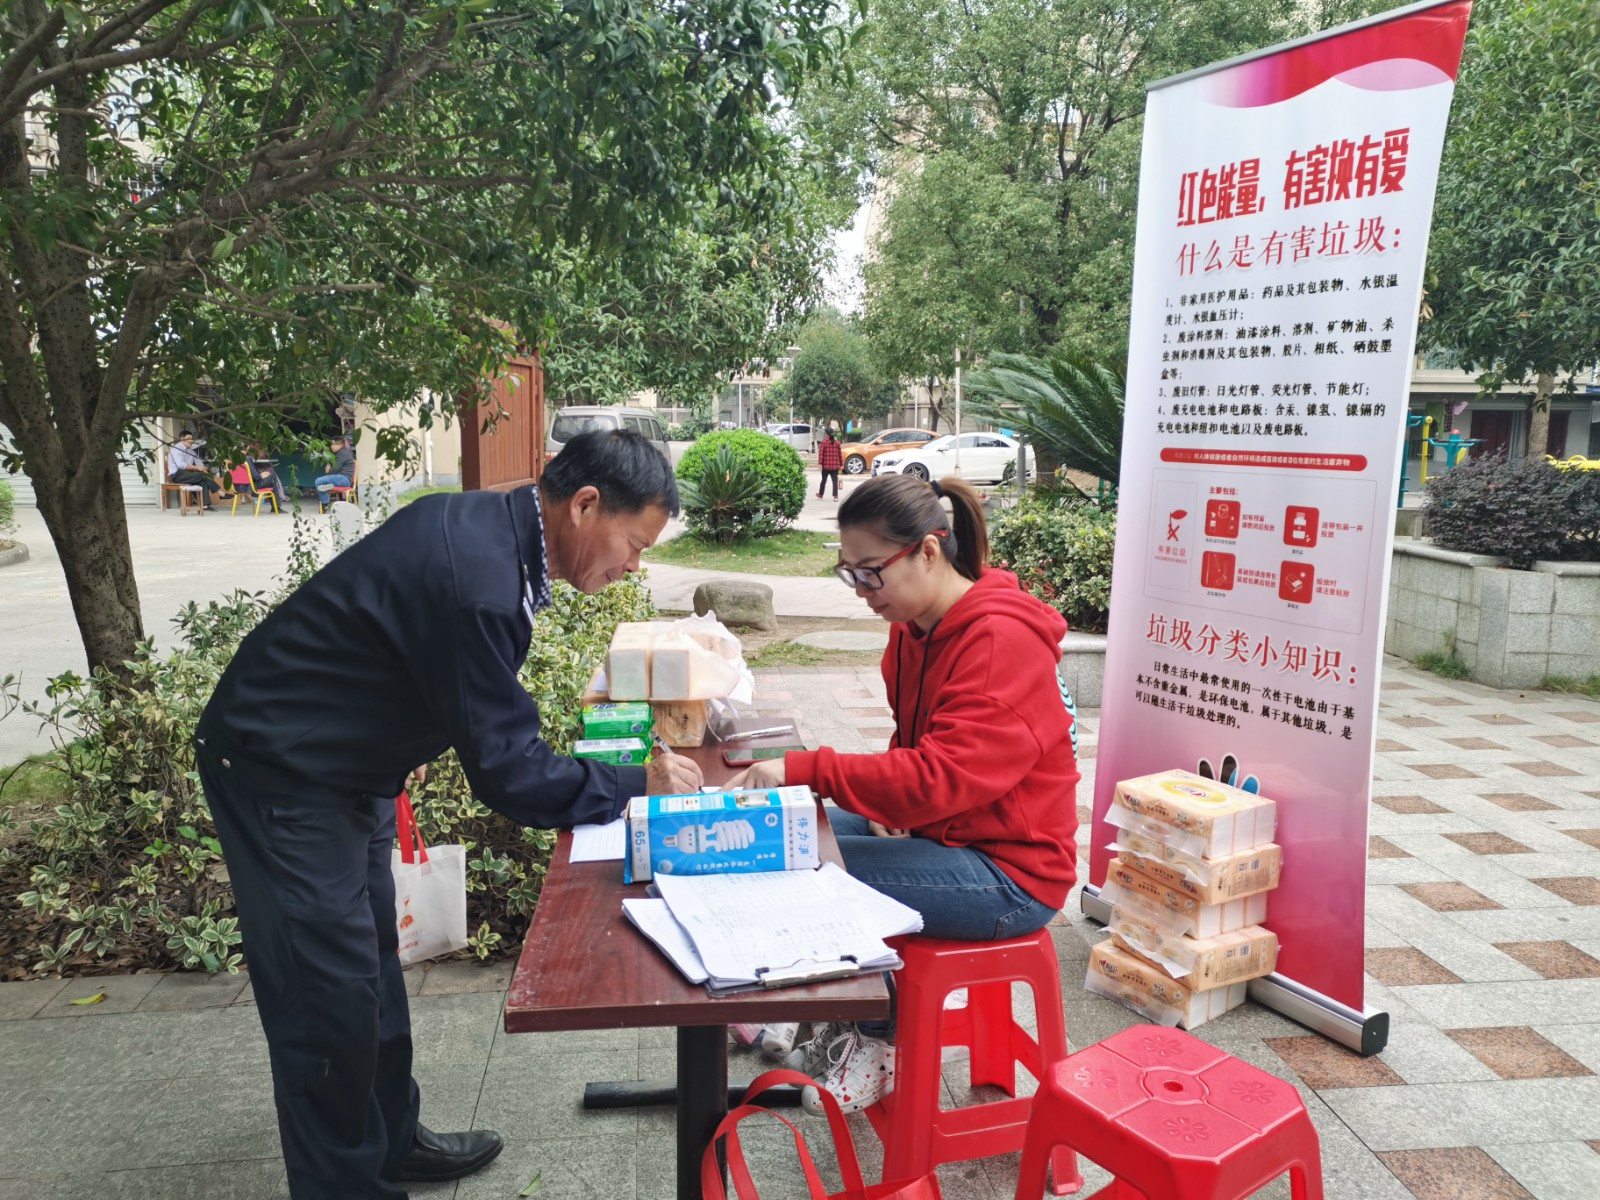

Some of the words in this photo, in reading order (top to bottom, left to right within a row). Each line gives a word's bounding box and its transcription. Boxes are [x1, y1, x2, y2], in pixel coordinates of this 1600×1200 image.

[1176, 127, 1411, 227] 红色能量，有害换有爱
[1176, 215, 1401, 277] 什么是有害垃圾：
[1146, 613, 1358, 685] 垃圾分类小知识：
